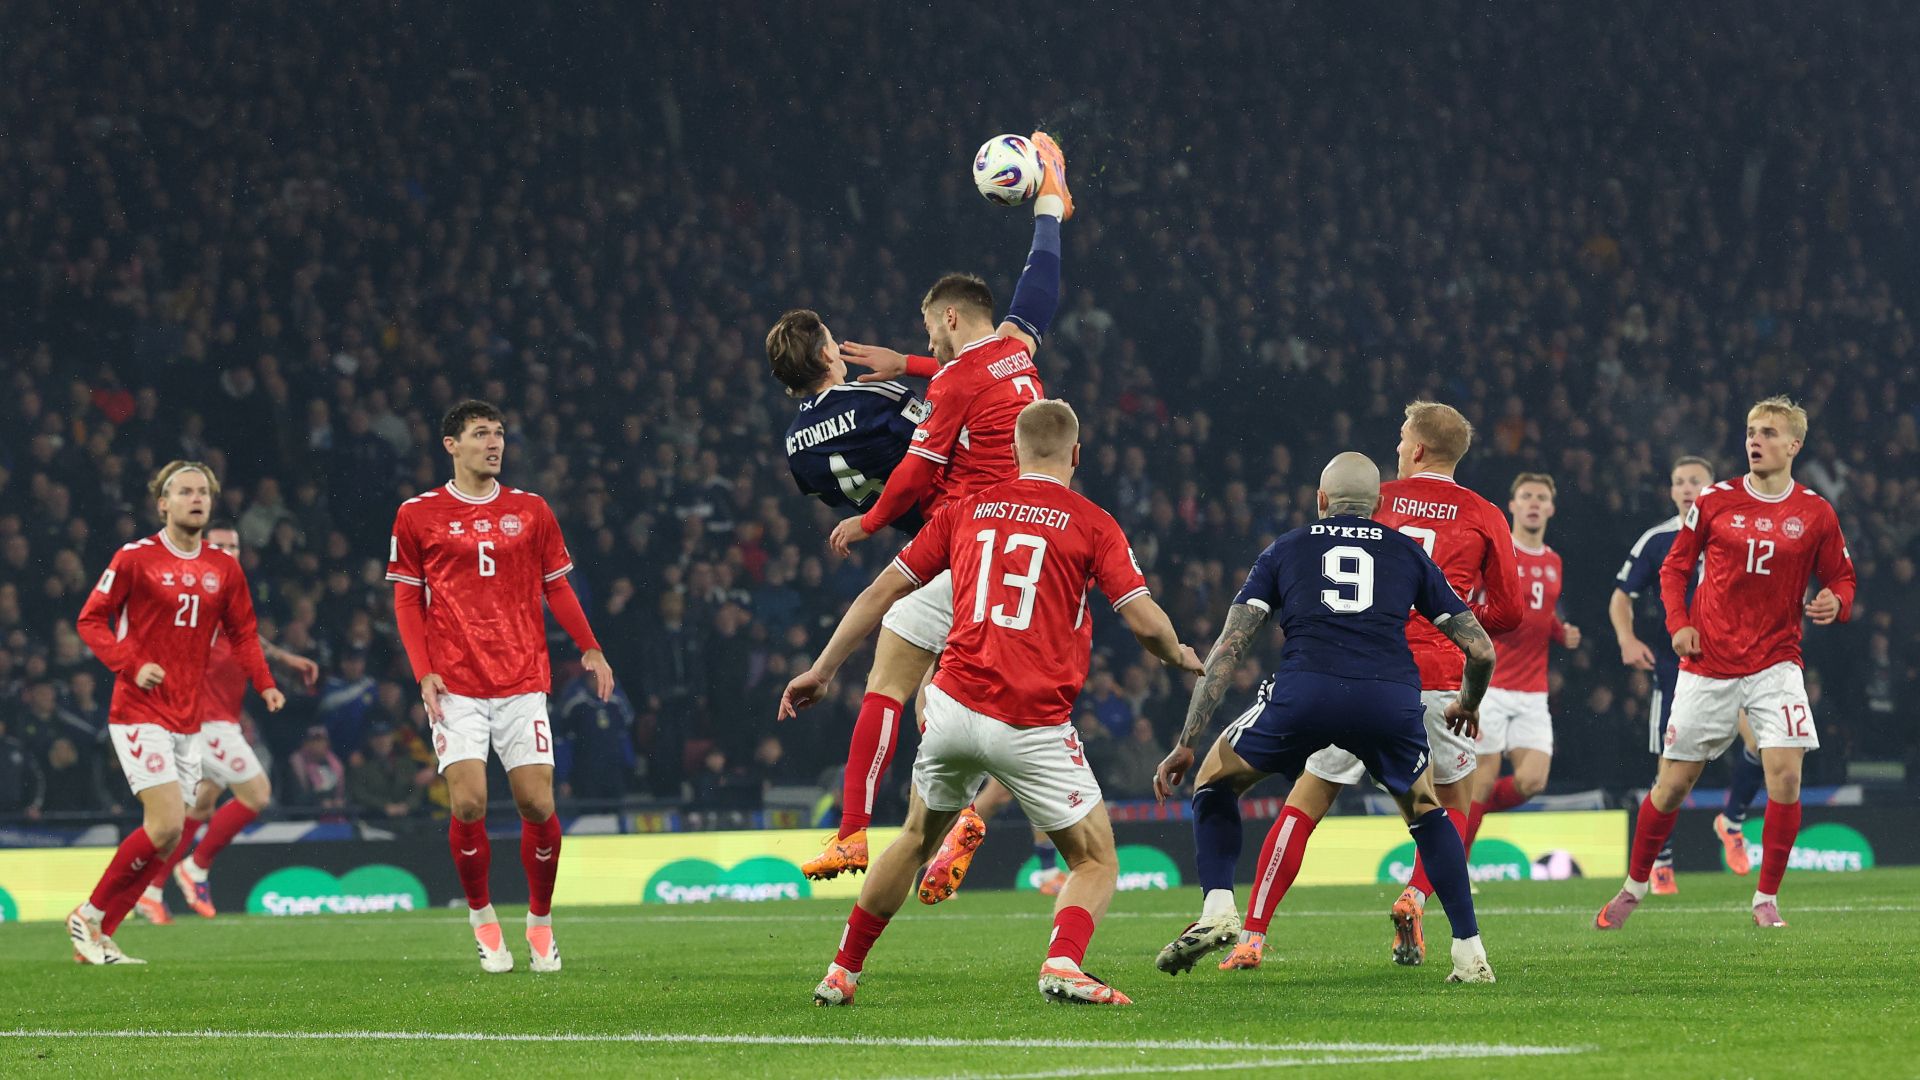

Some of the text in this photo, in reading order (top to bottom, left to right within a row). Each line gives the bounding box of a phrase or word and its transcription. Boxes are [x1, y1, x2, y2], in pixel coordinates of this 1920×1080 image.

[828, 452, 885, 507] 4
[973, 501, 1071, 531] KRISTENSEN
[1392, 497, 1458, 520] ISAKSEN
[1310, 524, 1383, 540] DYKES
[478, 541, 496, 577] 6
[1746, 537, 1775, 575] 12
[973, 528, 1047, 631] 13
[1320, 545, 1374, 614] 9
[1530, 581, 1544, 610] 9
[174, 593, 200, 628] 21
[534, 720, 549, 753] 6
[1780, 704, 1808, 737] 12
